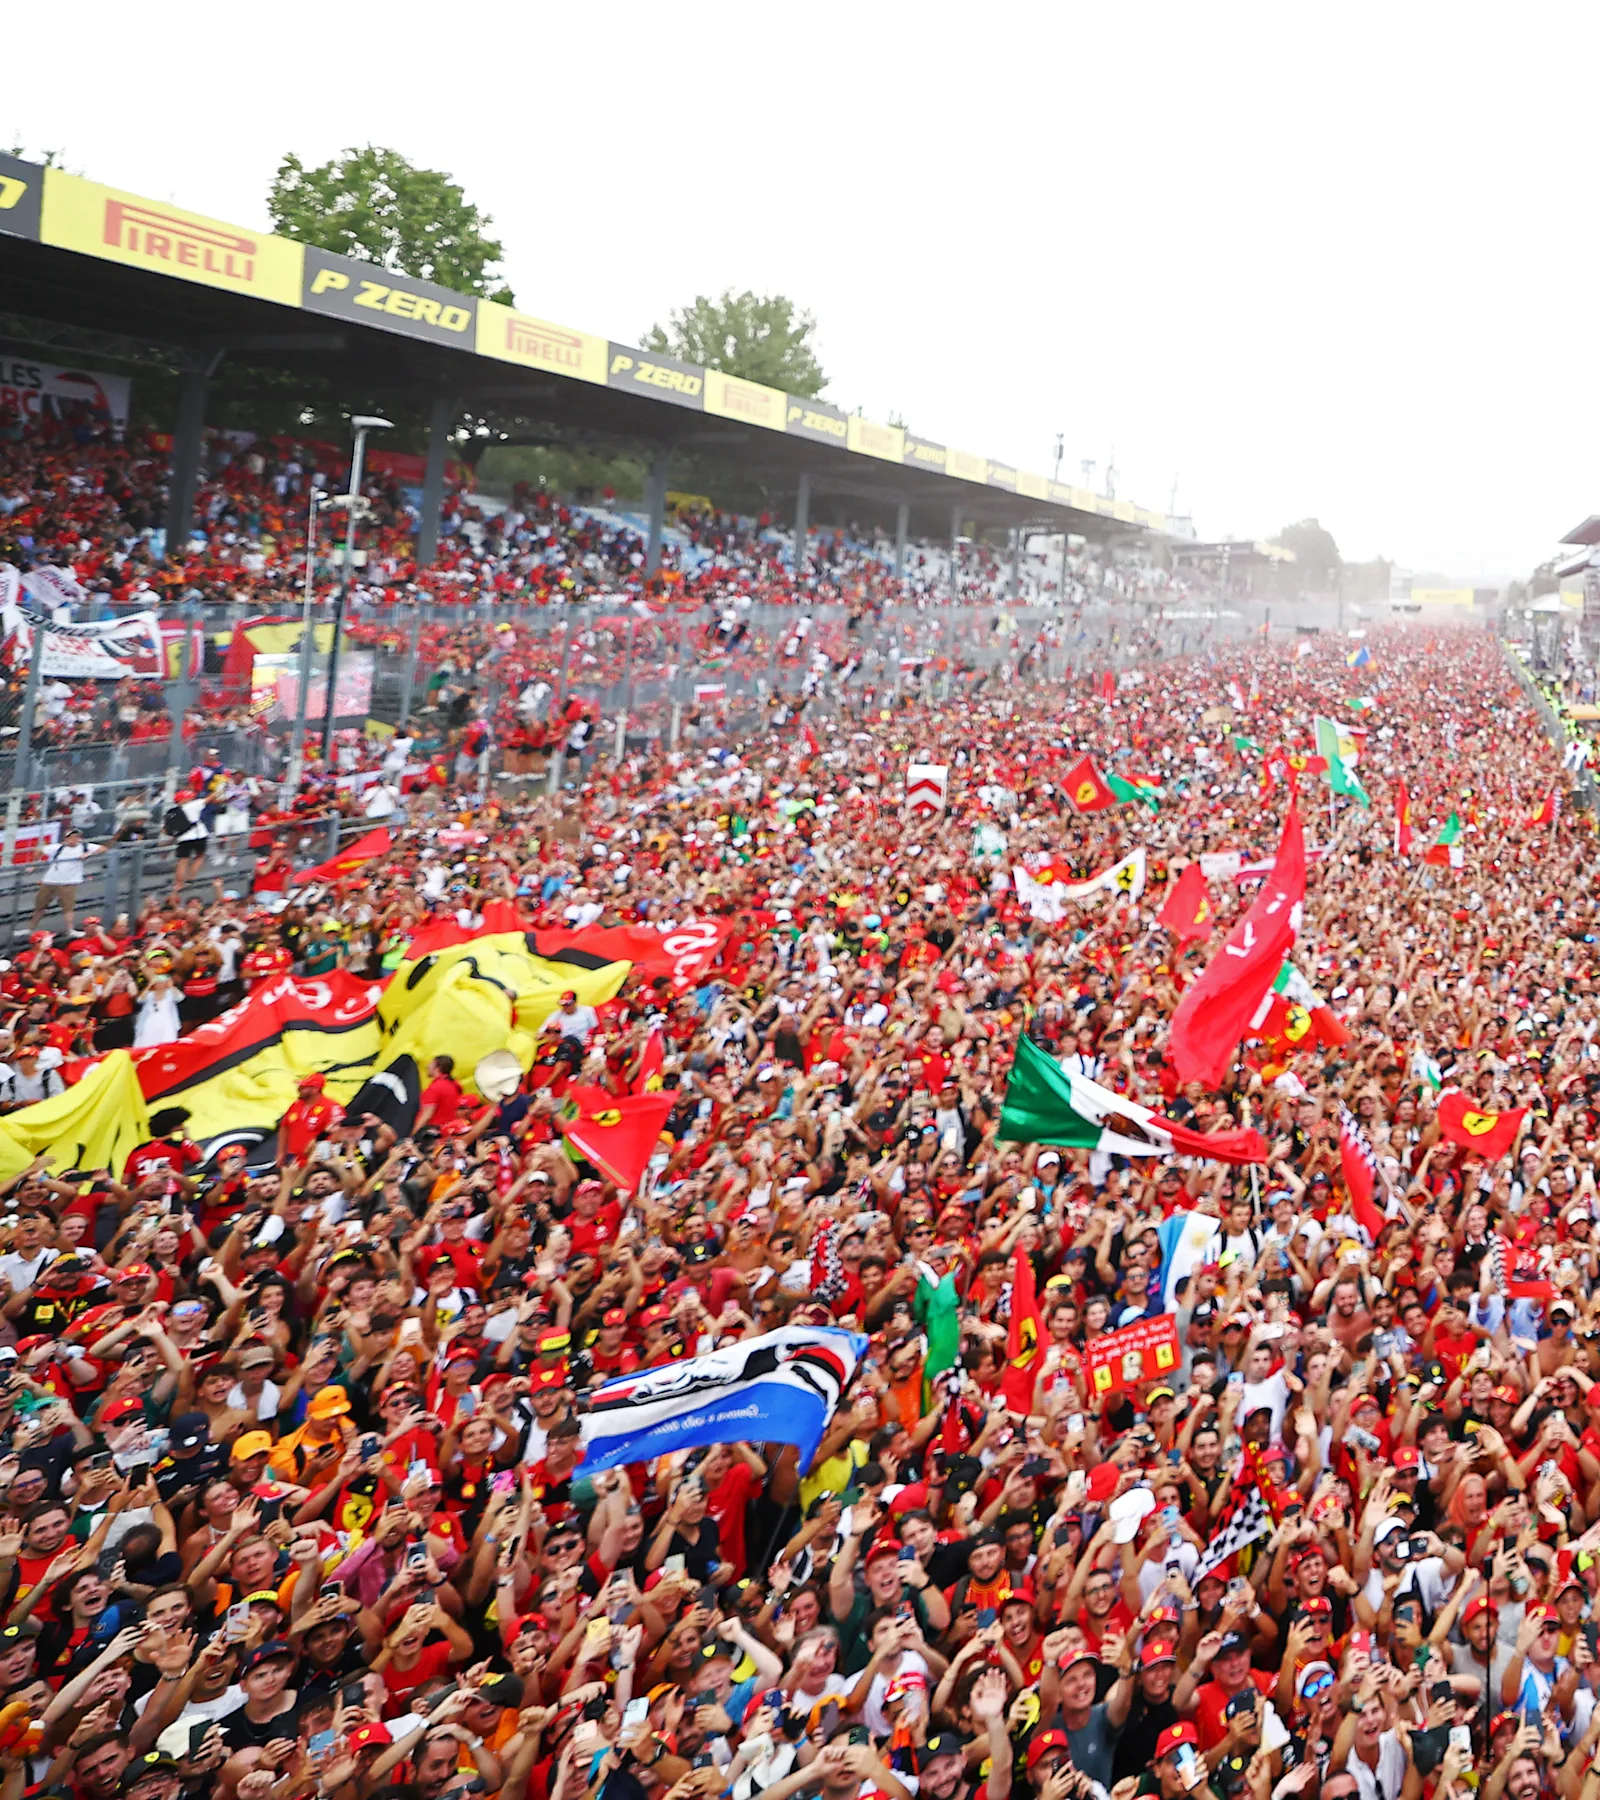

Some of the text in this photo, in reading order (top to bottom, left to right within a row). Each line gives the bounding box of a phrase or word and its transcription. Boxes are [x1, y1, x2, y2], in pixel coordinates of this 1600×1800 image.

[103, 198, 257, 282] PIRELLI
[310, 267, 471, 332] P ZERO
[505, 317, 582, 368] PIRELLI
[610, 354, 703, 397] P ZERO
